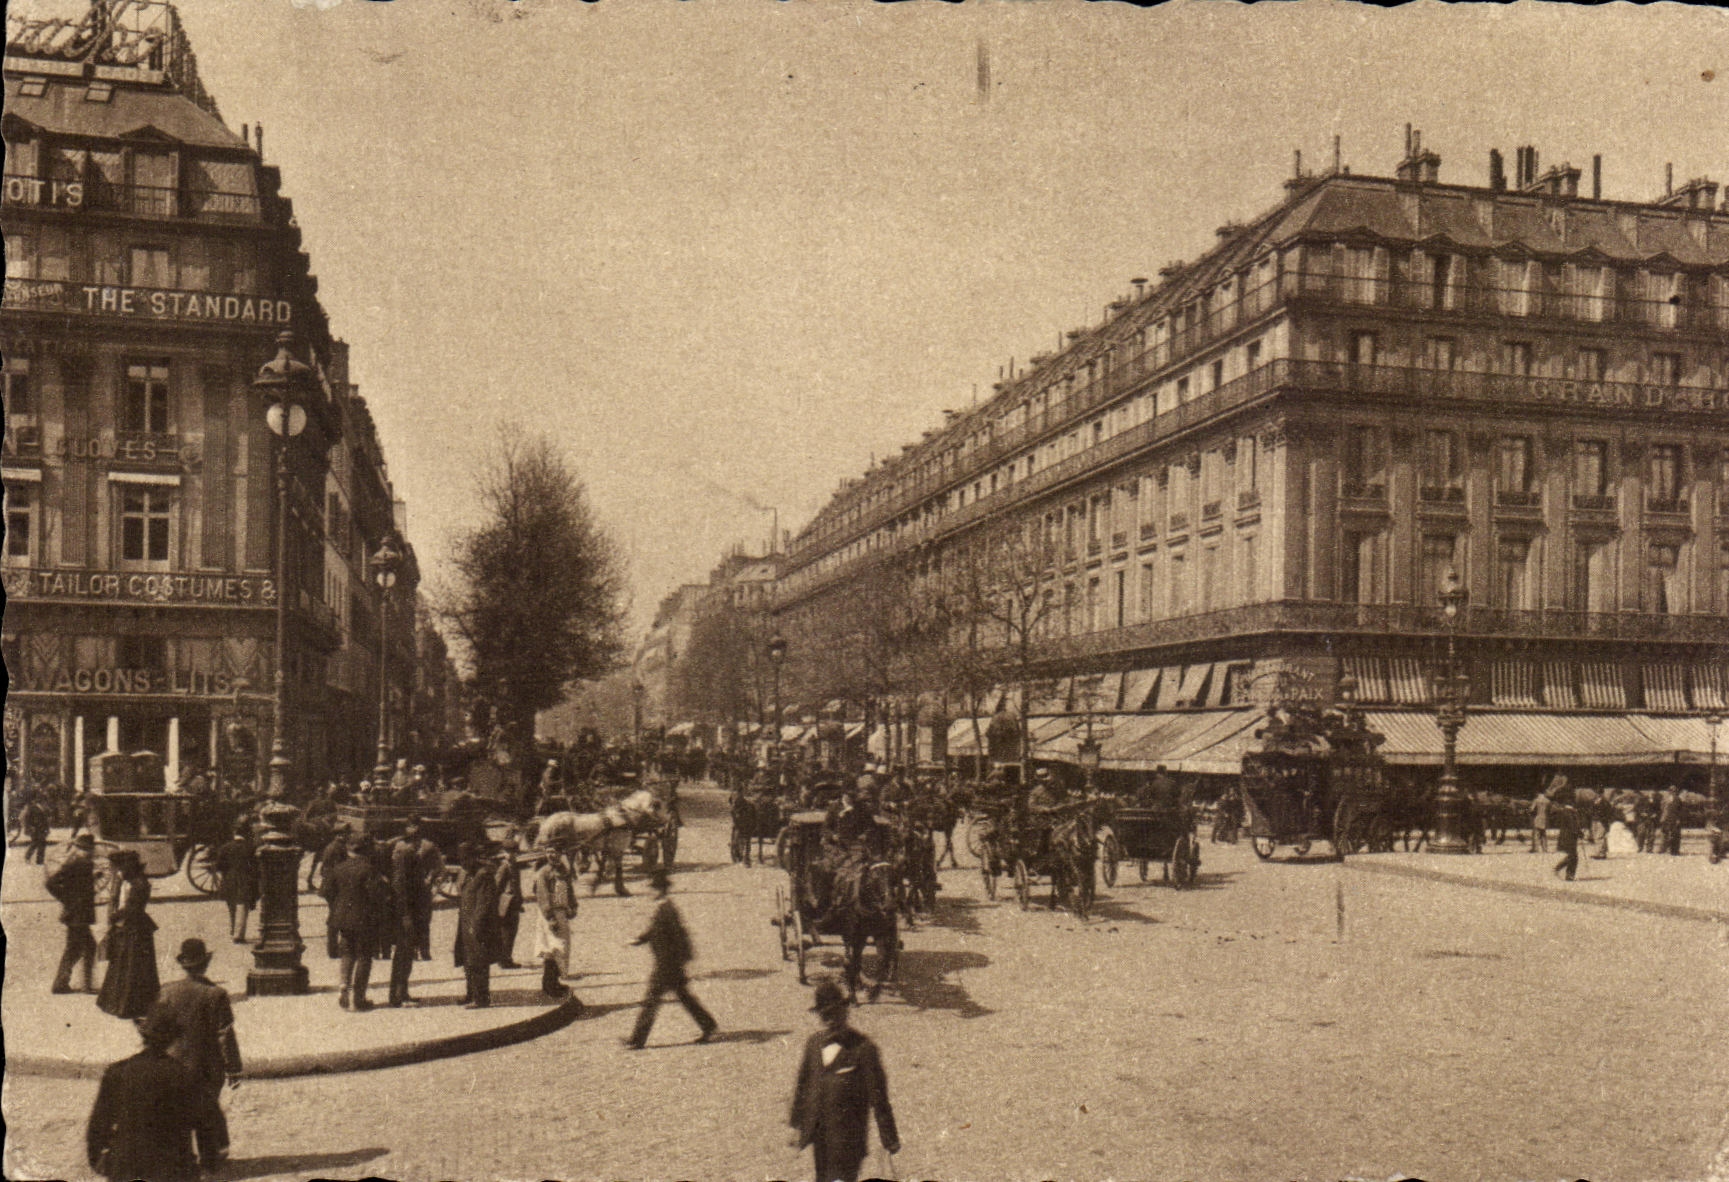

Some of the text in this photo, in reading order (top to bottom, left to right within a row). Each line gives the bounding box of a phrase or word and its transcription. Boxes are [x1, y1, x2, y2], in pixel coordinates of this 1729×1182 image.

[7, 178, 84, 207] OTIS
[82, 286, 291, 322] THE STANDARD
[1533, 379, 1663, 407] GRAND
[40, 572, 277, 601] TAILOR COSTUMES &
[1290, 687, 1324, 701] PAIX
